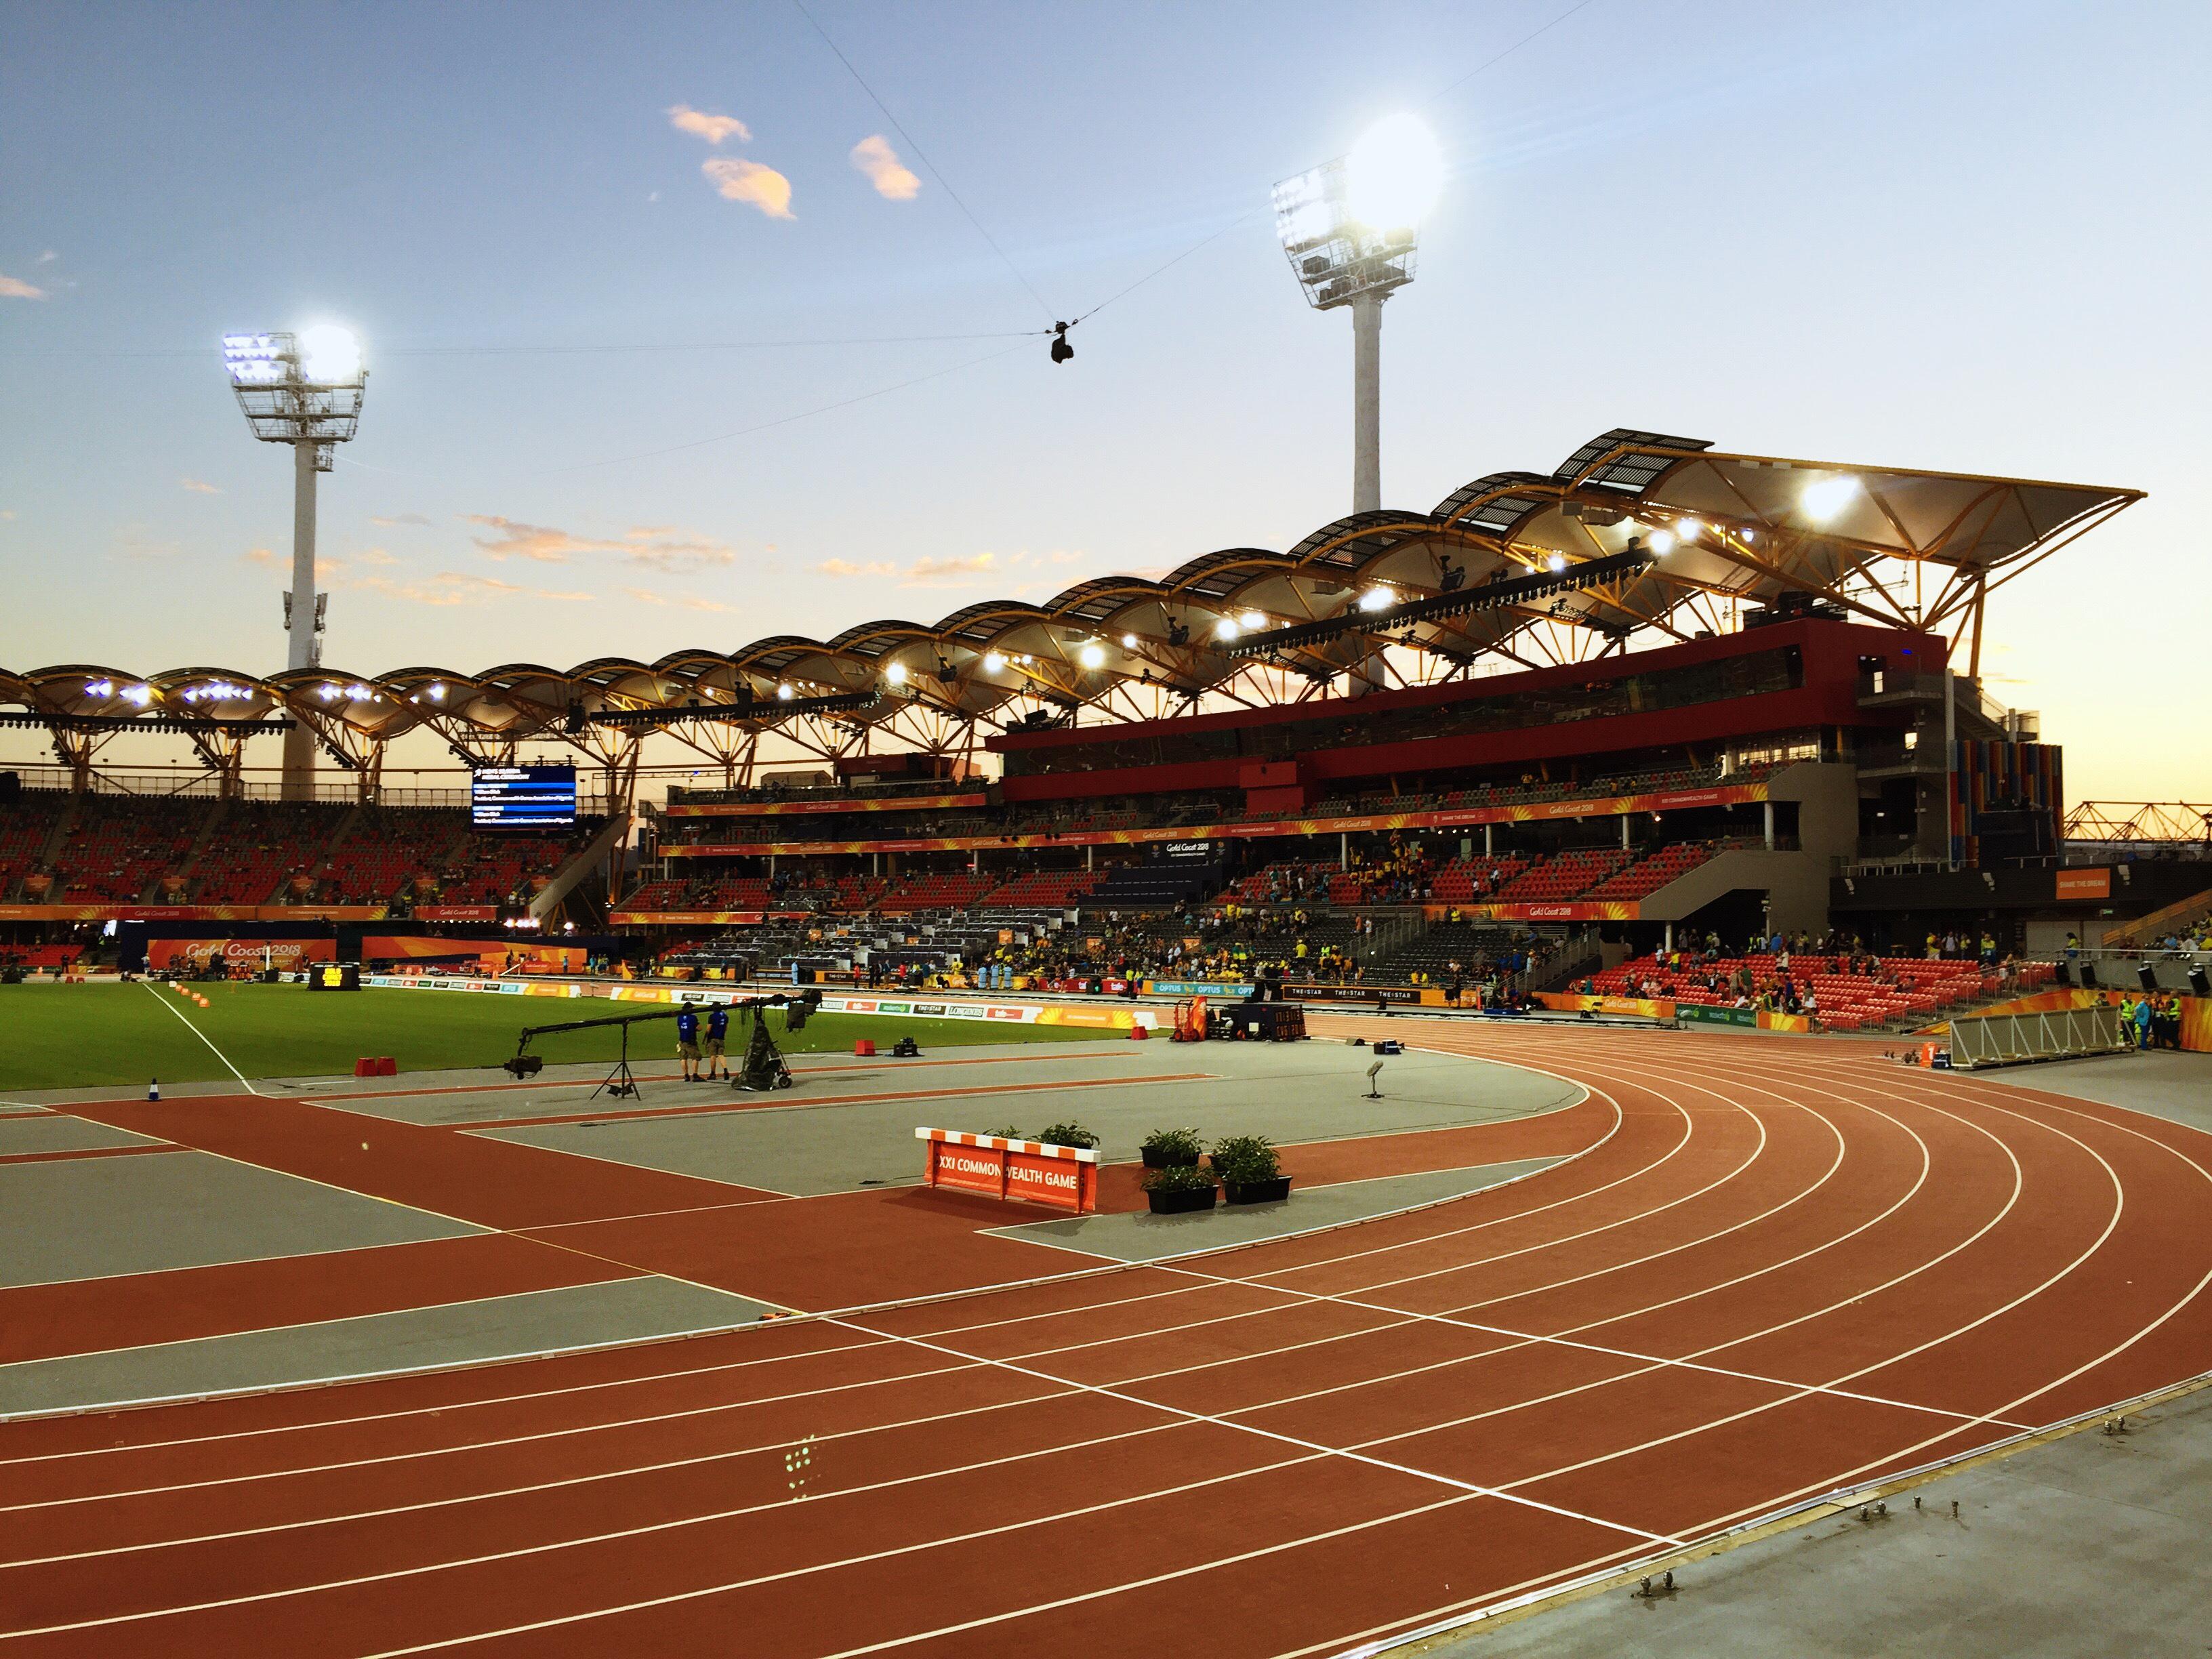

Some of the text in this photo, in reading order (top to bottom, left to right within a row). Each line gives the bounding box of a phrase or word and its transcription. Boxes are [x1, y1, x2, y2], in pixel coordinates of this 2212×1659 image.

[1564, 805, 1580, 813] Coast
[1166, 843, 1181, 852] Gold
[1530, 907, 1544, 916] Gold
[1544, 907, 1558, 916] Coast
[186, 943, 301, 957] Gold Coast 2018
[1238, 987, 1254, 995] OPT
[949, 1007, 983, 1017] LONGINES
[1928, 1047, 1934, 1060] 1
[939, 1155, 955, 1170] XXI
[1045, 1172, 1077, 1189] GAME
